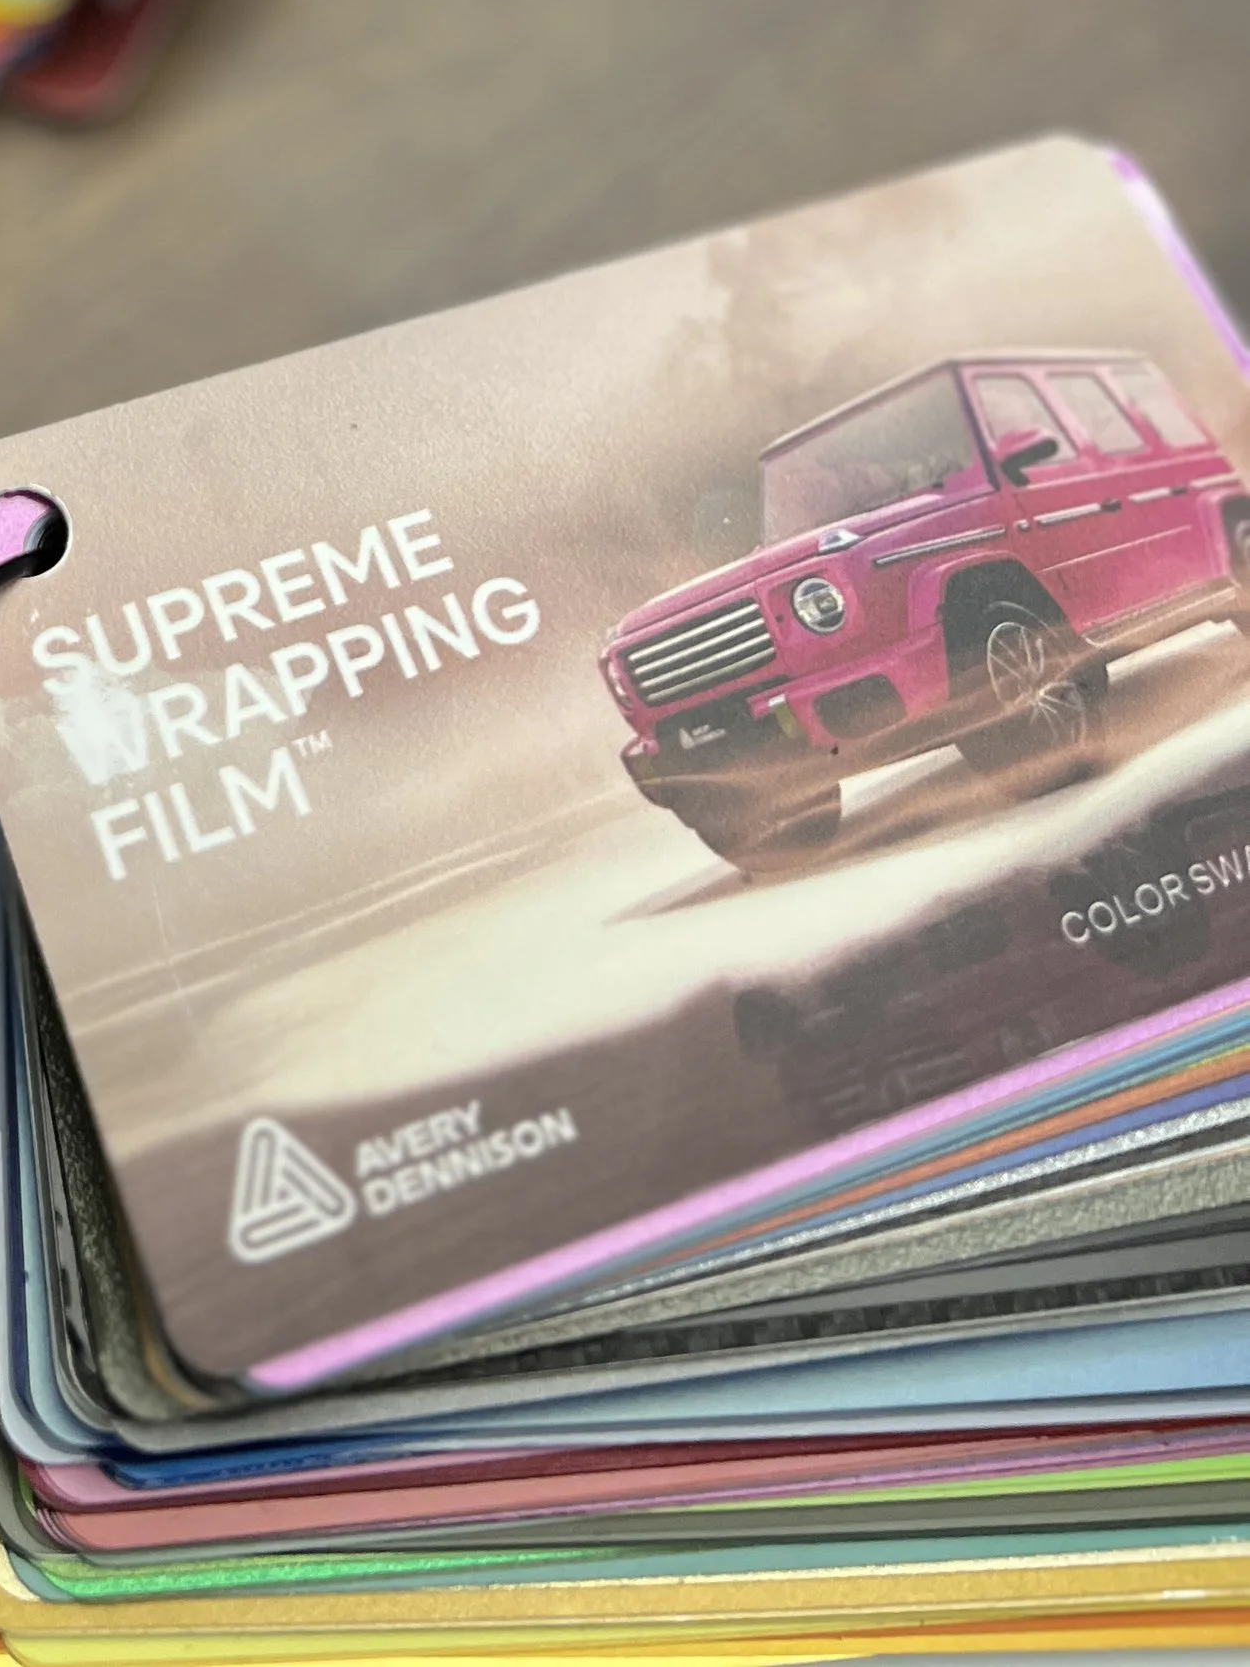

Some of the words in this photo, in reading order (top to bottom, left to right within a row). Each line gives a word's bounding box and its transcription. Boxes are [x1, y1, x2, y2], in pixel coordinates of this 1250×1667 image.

[32, 508, 453, 695] SUPREME
[1061, 873, 1190, 943] COLOR
[357, 1099, 481, 1177] AVERY
[364, 1108, 578, 1215] DENNISON
